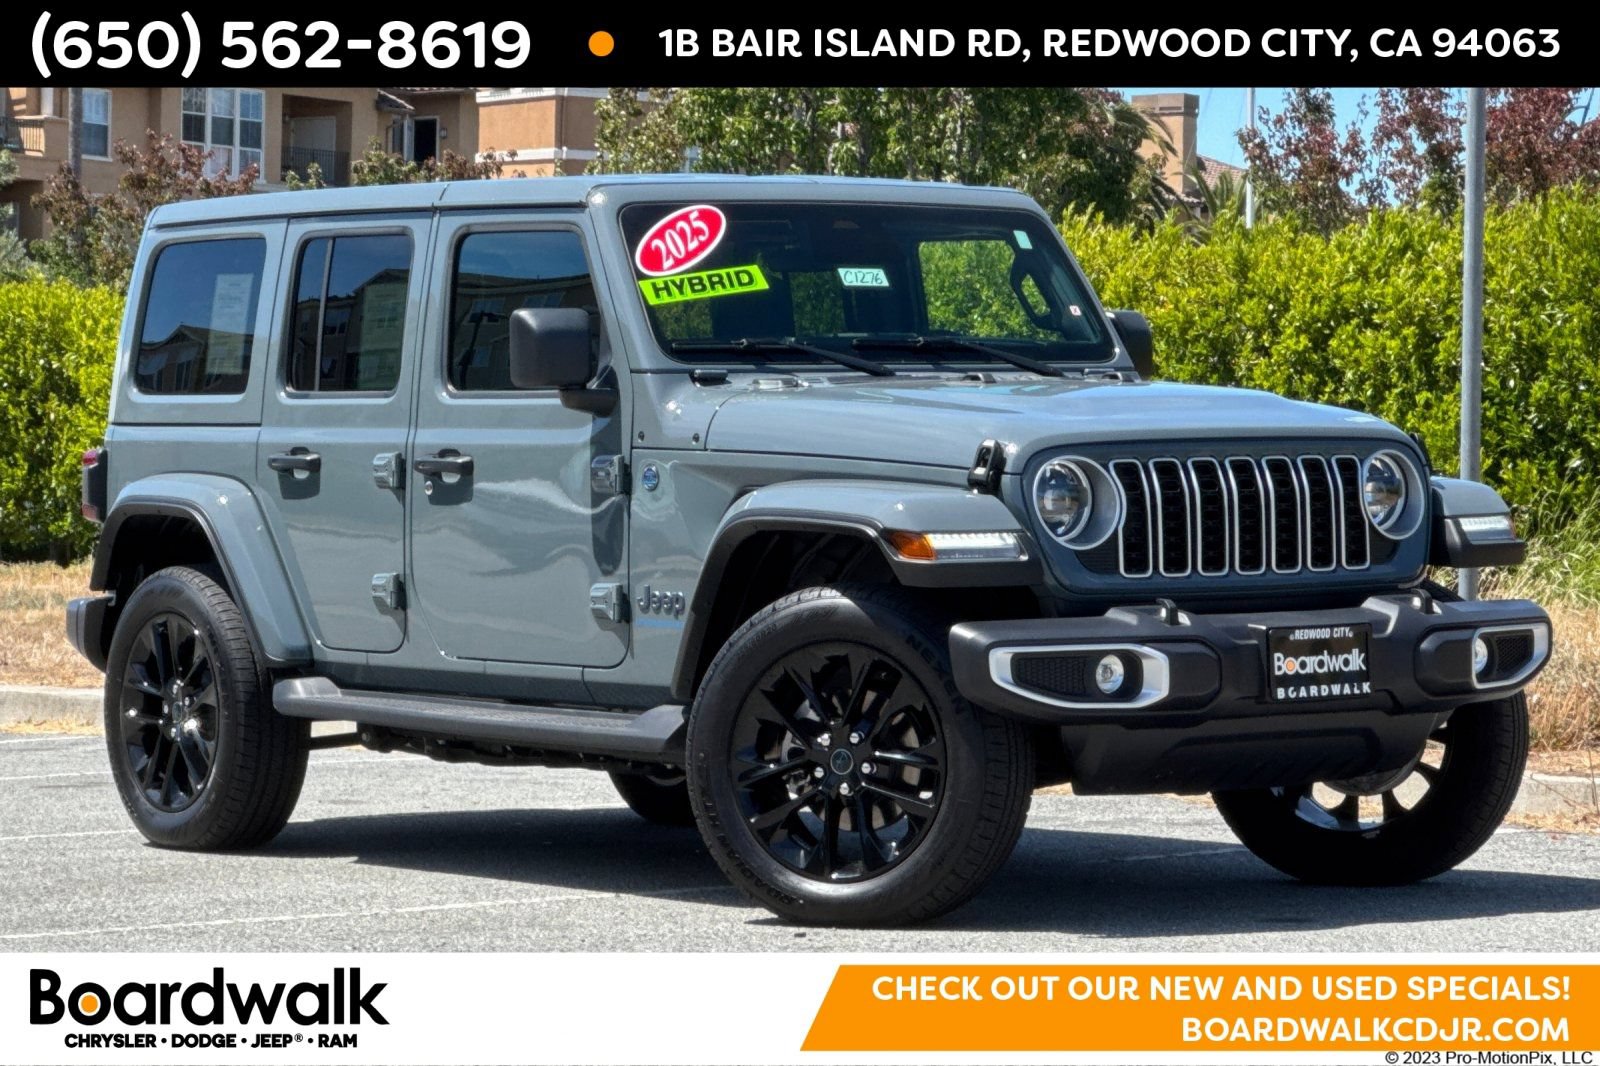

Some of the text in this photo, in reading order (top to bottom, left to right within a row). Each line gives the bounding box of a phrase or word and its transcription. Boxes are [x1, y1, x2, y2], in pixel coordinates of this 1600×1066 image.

[651, 209, 709, 270] 2025
[651, 269, 755, 299] HYBRID
[844, 270, 883, 284] C1276
[637, 584, 686, 619] Jeep
[1294, 627, 1350, 640] REDWOOD CITY
[1274, 648, 1367, 675] Boardwalk
[1277, 682, 1371, 699] BOARDWALK
